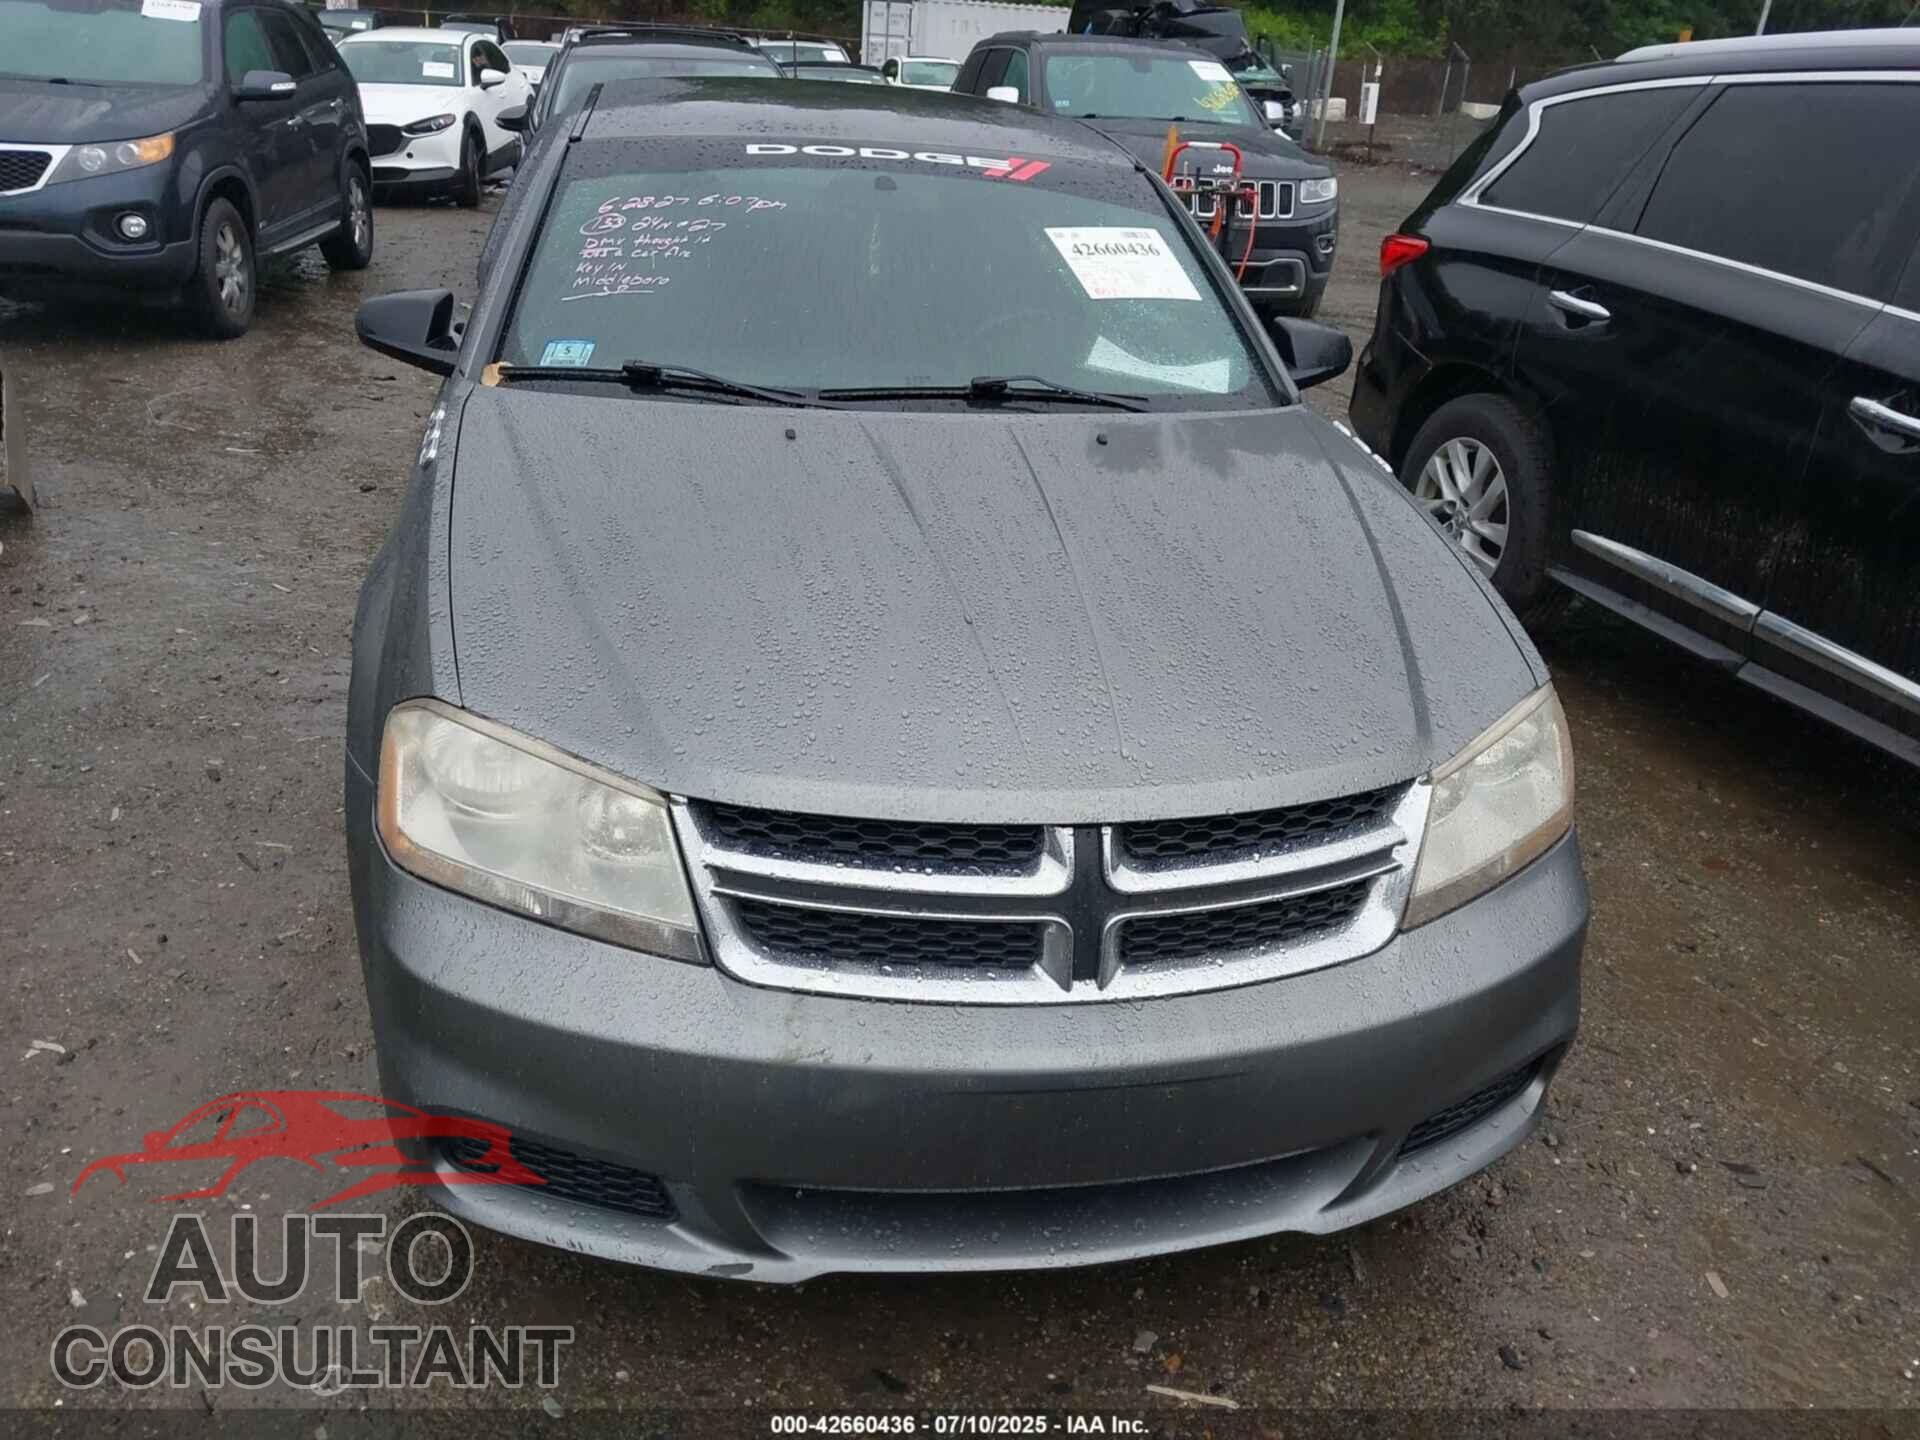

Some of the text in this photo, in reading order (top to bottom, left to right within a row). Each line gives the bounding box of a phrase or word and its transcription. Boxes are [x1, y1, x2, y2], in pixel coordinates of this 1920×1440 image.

[746, 144, 1012, 172] DODGE
[1212, 163, 1233, 173] Jee
[1071, 242, 1161, 257] 42660436
